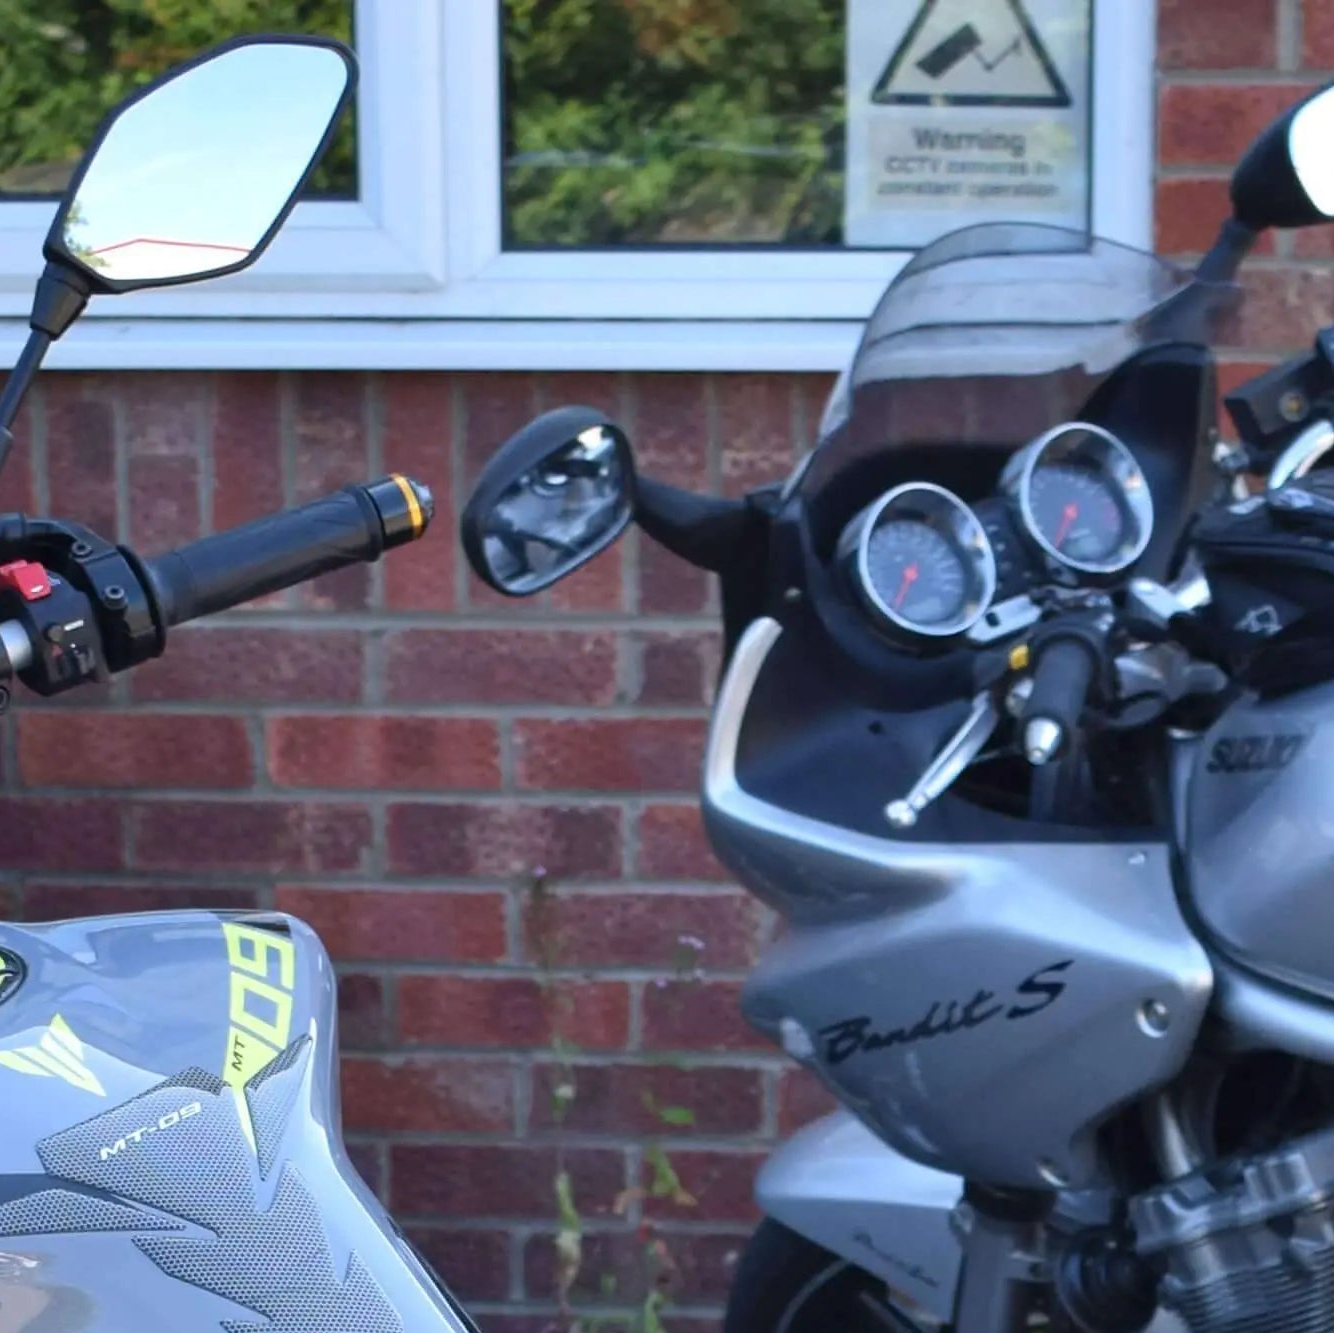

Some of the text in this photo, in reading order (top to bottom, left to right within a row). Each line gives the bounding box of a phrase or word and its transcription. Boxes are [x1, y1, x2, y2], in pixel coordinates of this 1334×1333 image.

[883, 155, 942, 174] CCTV
[912, 128, 1027, 159] Warning
[221, 921, 295, 1073] MT 09
[817, 959, 1075, 1065] Bandit S
[99, 1101, 202, 1162] MT-09
